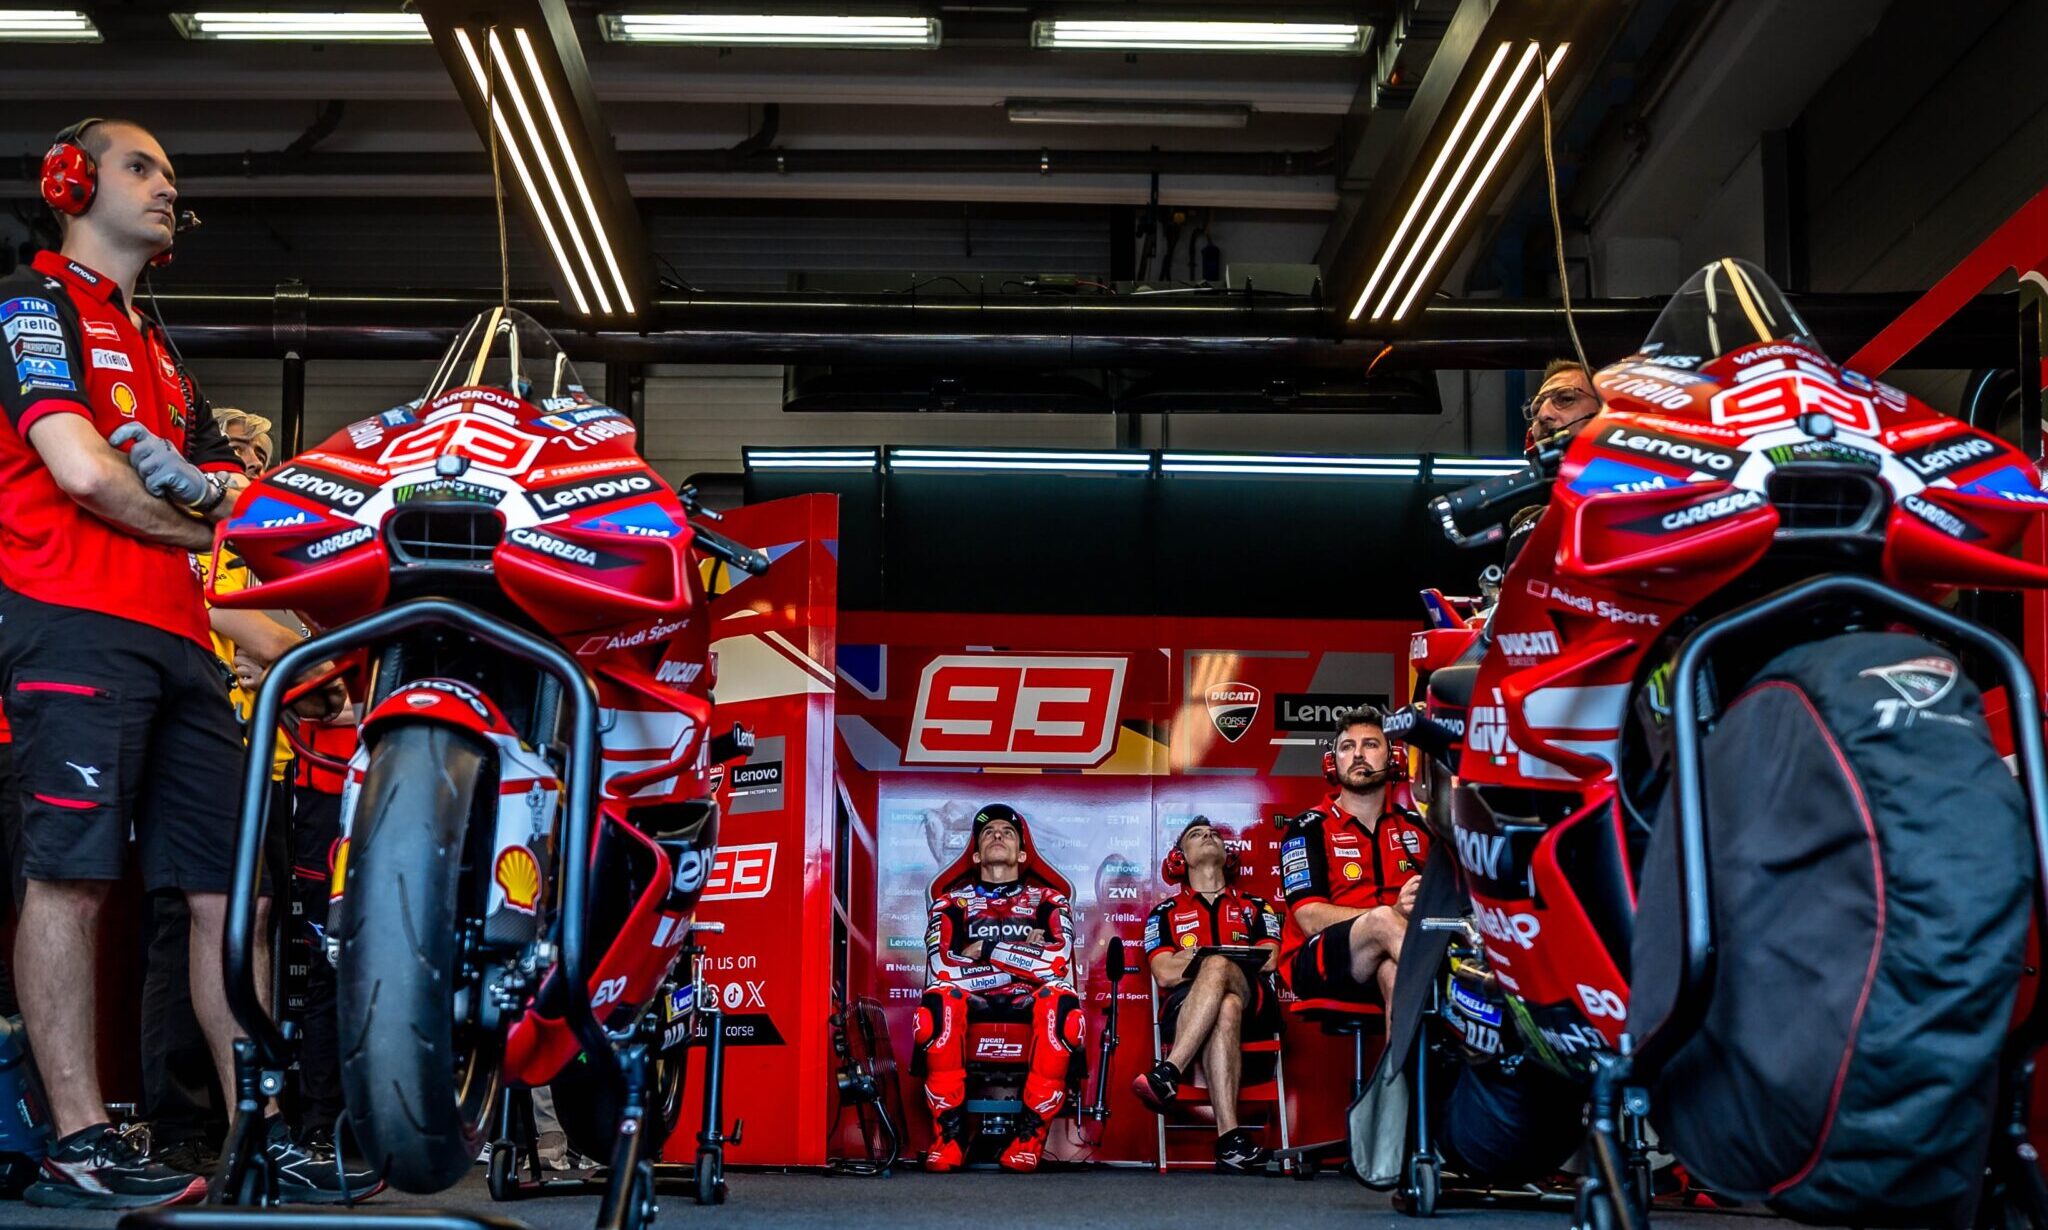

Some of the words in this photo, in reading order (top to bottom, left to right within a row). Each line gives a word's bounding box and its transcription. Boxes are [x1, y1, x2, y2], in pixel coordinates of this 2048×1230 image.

[68, 262, 97, 284] Lenovo
[21, 301, 49, 312] TIM
[16, 319, 57, 332] riello
[104, 355, 129, 368] riello
[1613, 373, 1694, 410] riello
[432, 390, 521, 410] VARGROUP
[1723, 376, 1871, 431] 93
[387, 418, 534, 472] 93
[1607, 429, 1734, 471] Lenovo
[1904, 438, 1995, 476] Lenovo
[273, 467, 365, 507] Lenovo
[416, 479, 501, 500] MONSTER
[532, 476, 652, 513] Lenovo
[1661, 491, 1761, 530] CARRERA
[306, 525, 374, 559] CARRERA
[511, 528, 598, 566] CARRERA
[1551, 586, 1594, 613] Audi
[1597, 600, 1661, 627] Sport
[606, 627, 646, 650] Audi
[648, 617, 692, 641] Sport
[1496, 630, 1560, 656] DUCATI
[655, 660, 705, 683] DUCATI
[1211, 691, 1255, 701] DUCATI
[920, 667, 1114, 753] 93
[1218, 716, 1248, 726] CORSE
[1383, 711, 1415, 733] Lenovo
[734, 768, 778, 783] Lenovo
[1121, 815, 1140, 825] TIM
[1288, 840, 1301, 848] TIM
[1106, 864, 1140, 873] Lenovo
[1108, 887, 1137, 899] ZYN
[1111, 913, 1135, 922] riello
[968, 924, 1033, 938] Lenovo
[889, 937, 924, 948] Lenovo
[1013, 945, 1041, 956] Lenovo
[717, 956, 734, 970] us
[738, 955, 756, 969] on
[1008, 953, 1034, 968] Unipol
[962, 965, 991, 975] Lenovo
[971, 976, 997, 988] Unipol
[902, 988, 922, 999] TIM
[1106, 992, 1125, 1000] Adi
[1126, 993, 1149, 1001] Sport
